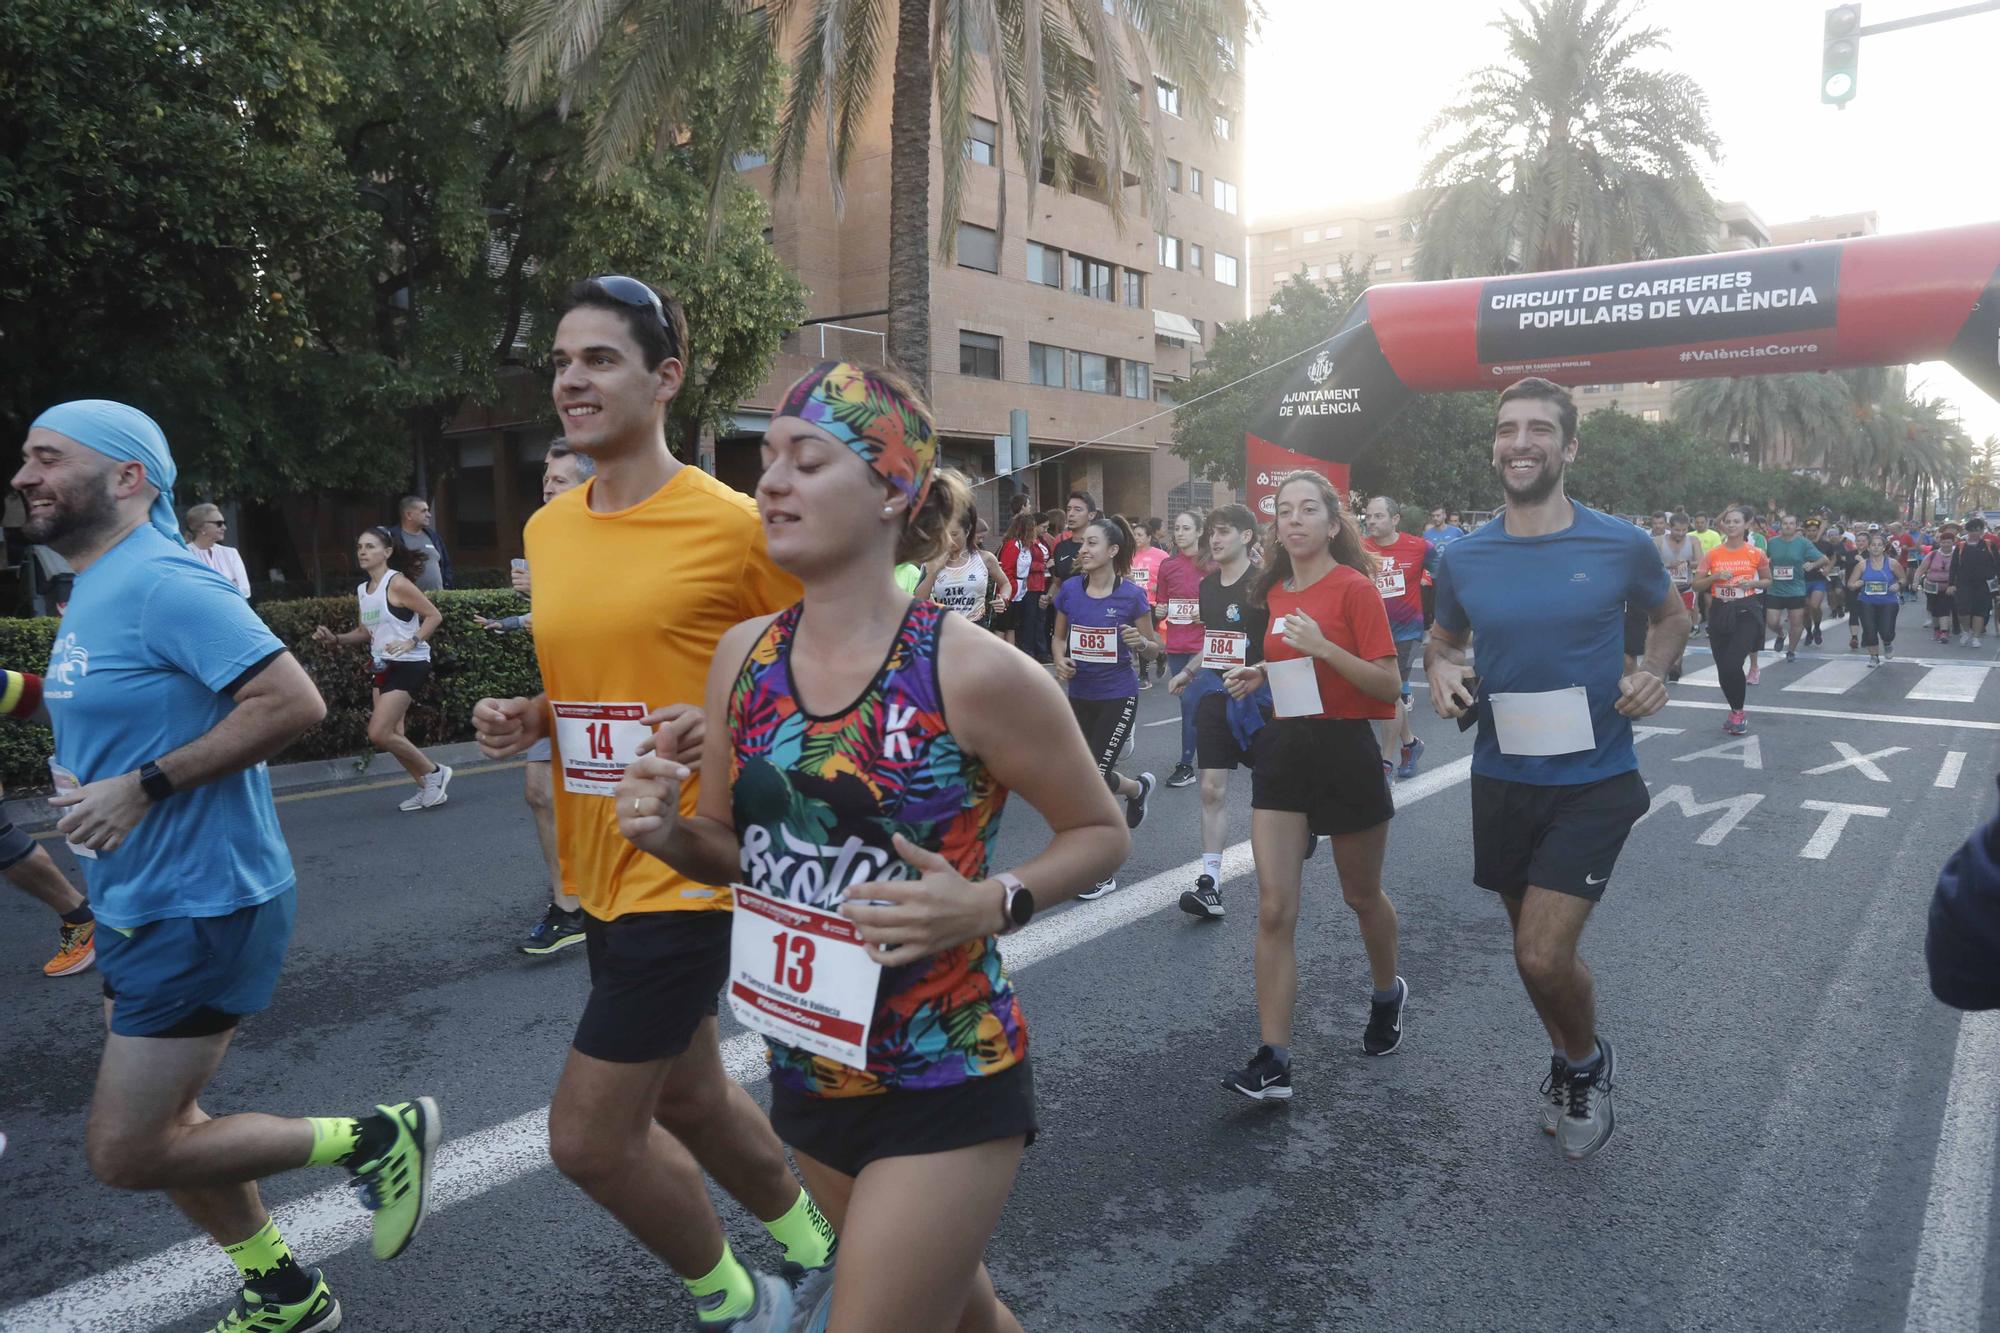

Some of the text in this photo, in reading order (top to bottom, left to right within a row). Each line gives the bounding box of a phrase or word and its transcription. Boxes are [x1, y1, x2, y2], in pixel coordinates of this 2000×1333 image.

[1491, 271, 1752, 310] CIRCUIT DE CARRERES
[1519, 286, 1818, 330] POPULARS DE VALÈNCIA
[1679, 343, 1818, 362] #ValènciaCorre
[1281, 388, 1361, 404] AJUNTAMENT
[1279, 401, 1362, 417] DE VALÈNCIA
[1377, 577, 1395, 588] 514
[944, 587, 965, 596] 21K
[1720, 588, 1736, 597] 496
[1176, 604, 1195, 615] 262
[1080, 634, 1105, 649] 683
[1211, 639, 1233, 655] 684
[1121, 707, 1133, 722] MY
[883, 703, 918, 760] K
[1108, 721, 1127, 748] RULES
[585, 722, 614, 760] 14
[1102, 748, 1114, 762] MY
[1632, 782, 1891, 860] MT
[772, 931, 816, 994] 13
